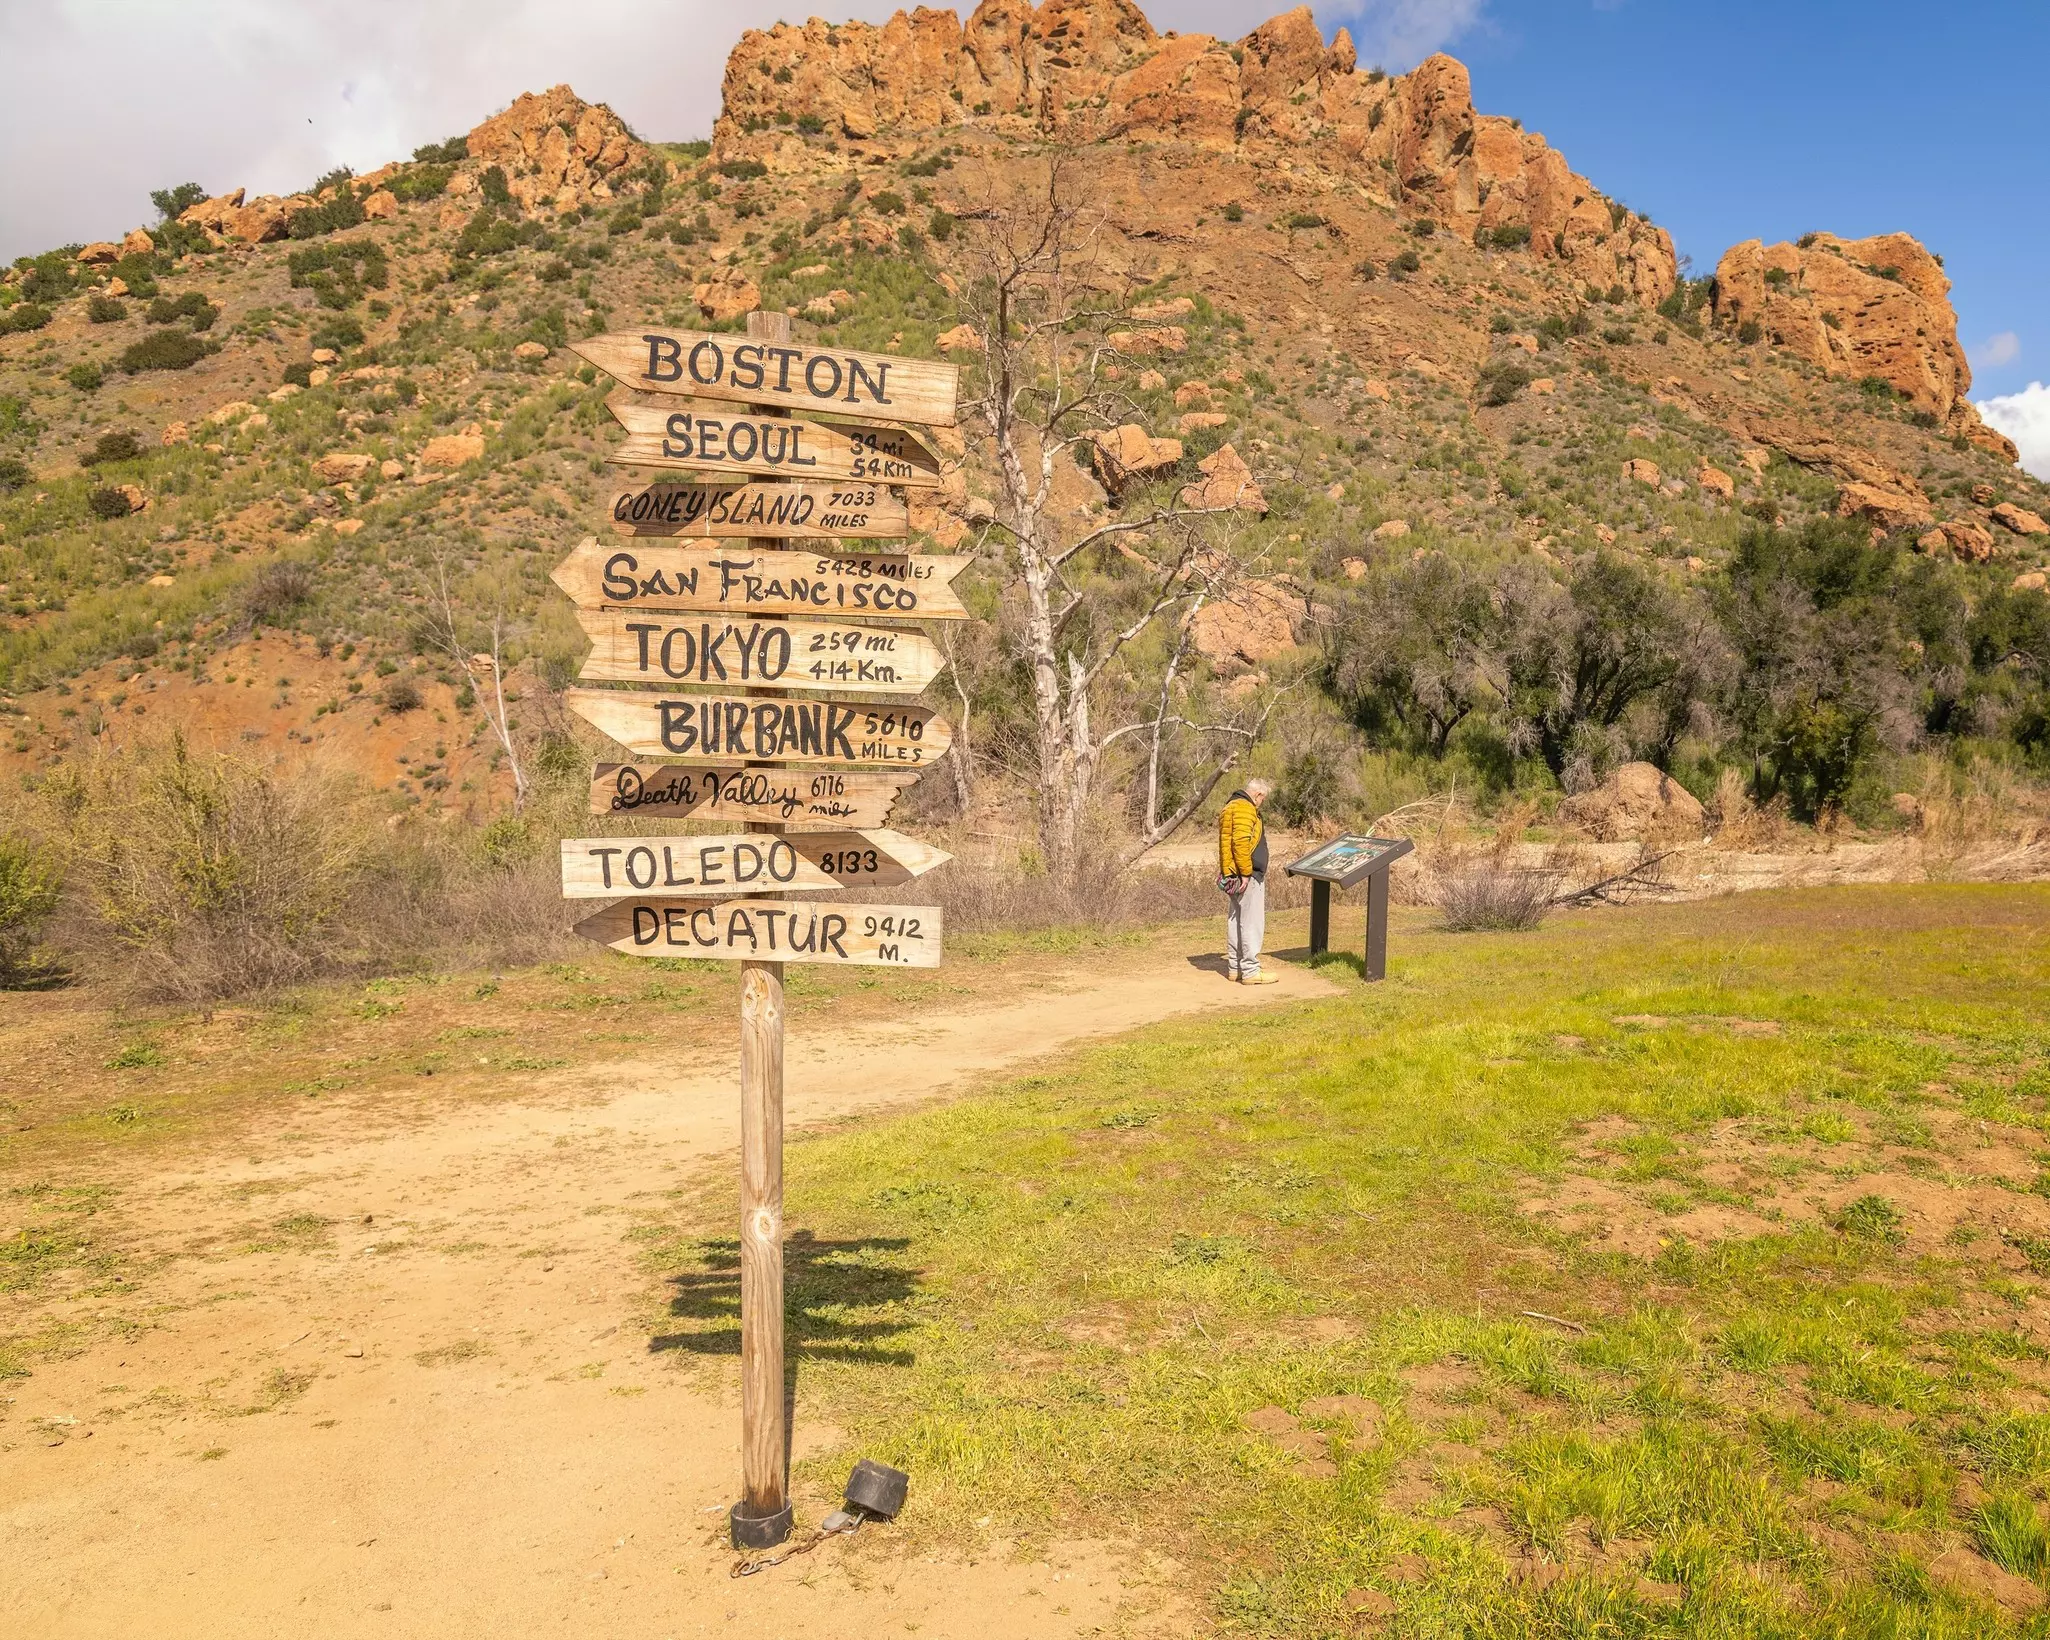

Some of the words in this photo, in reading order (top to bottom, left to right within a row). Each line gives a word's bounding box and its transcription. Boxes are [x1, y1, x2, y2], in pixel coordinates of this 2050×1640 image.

[642, 334, 892, 405] BOSTON
[662, 413, 816, 466] SEOUL
[850, 432, 880, 456] 34
[849, 457, 882, 478] 54
[614, 487, 707, 523] CONEY
[706, 490, 815, 526] ISLAND
[828, 491, 876, 507] 7033
[819, 513, 869, 529] MILES
[815, 559, 872, 579] 5428
[625, 622, 792, 683] TOKYO
[808, 631, 863, 654] 259
[864, 633, 899, 652] mi
[808, 659, 854, 682] 414
[654, 699, 857, 761] BURBANK
[864, 712, 924, 742] 5610
[612, 766, 698, 812] Death
[702, 770, 805, 819] Valley
[588, 840, 797, 890] TOLEDO
[819, 849, 879, 875] 8133
[632, 905, 849, 960] DECATUR
[863, 915, 925, 941] 9412
[878, 943, 909, 964] M.
